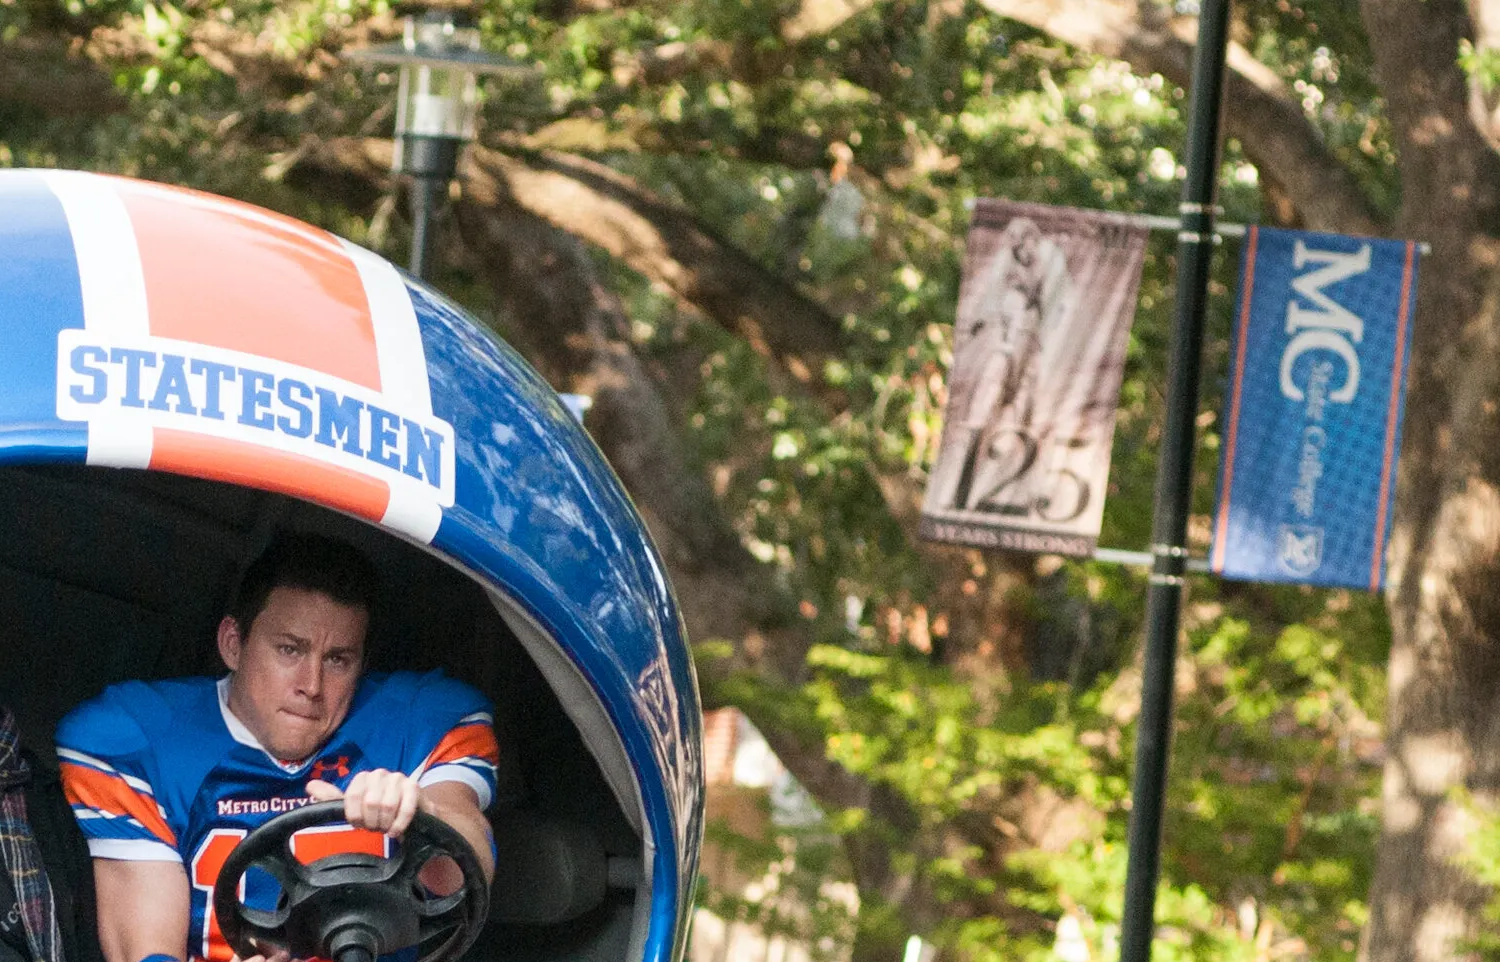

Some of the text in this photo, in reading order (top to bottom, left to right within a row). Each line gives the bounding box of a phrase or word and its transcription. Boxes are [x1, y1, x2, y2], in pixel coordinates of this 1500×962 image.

[1278, 239, 1372, 402] MC
[69, 345, 444, 489] STATESMEN
[946, 427, 1092, 522] 125
